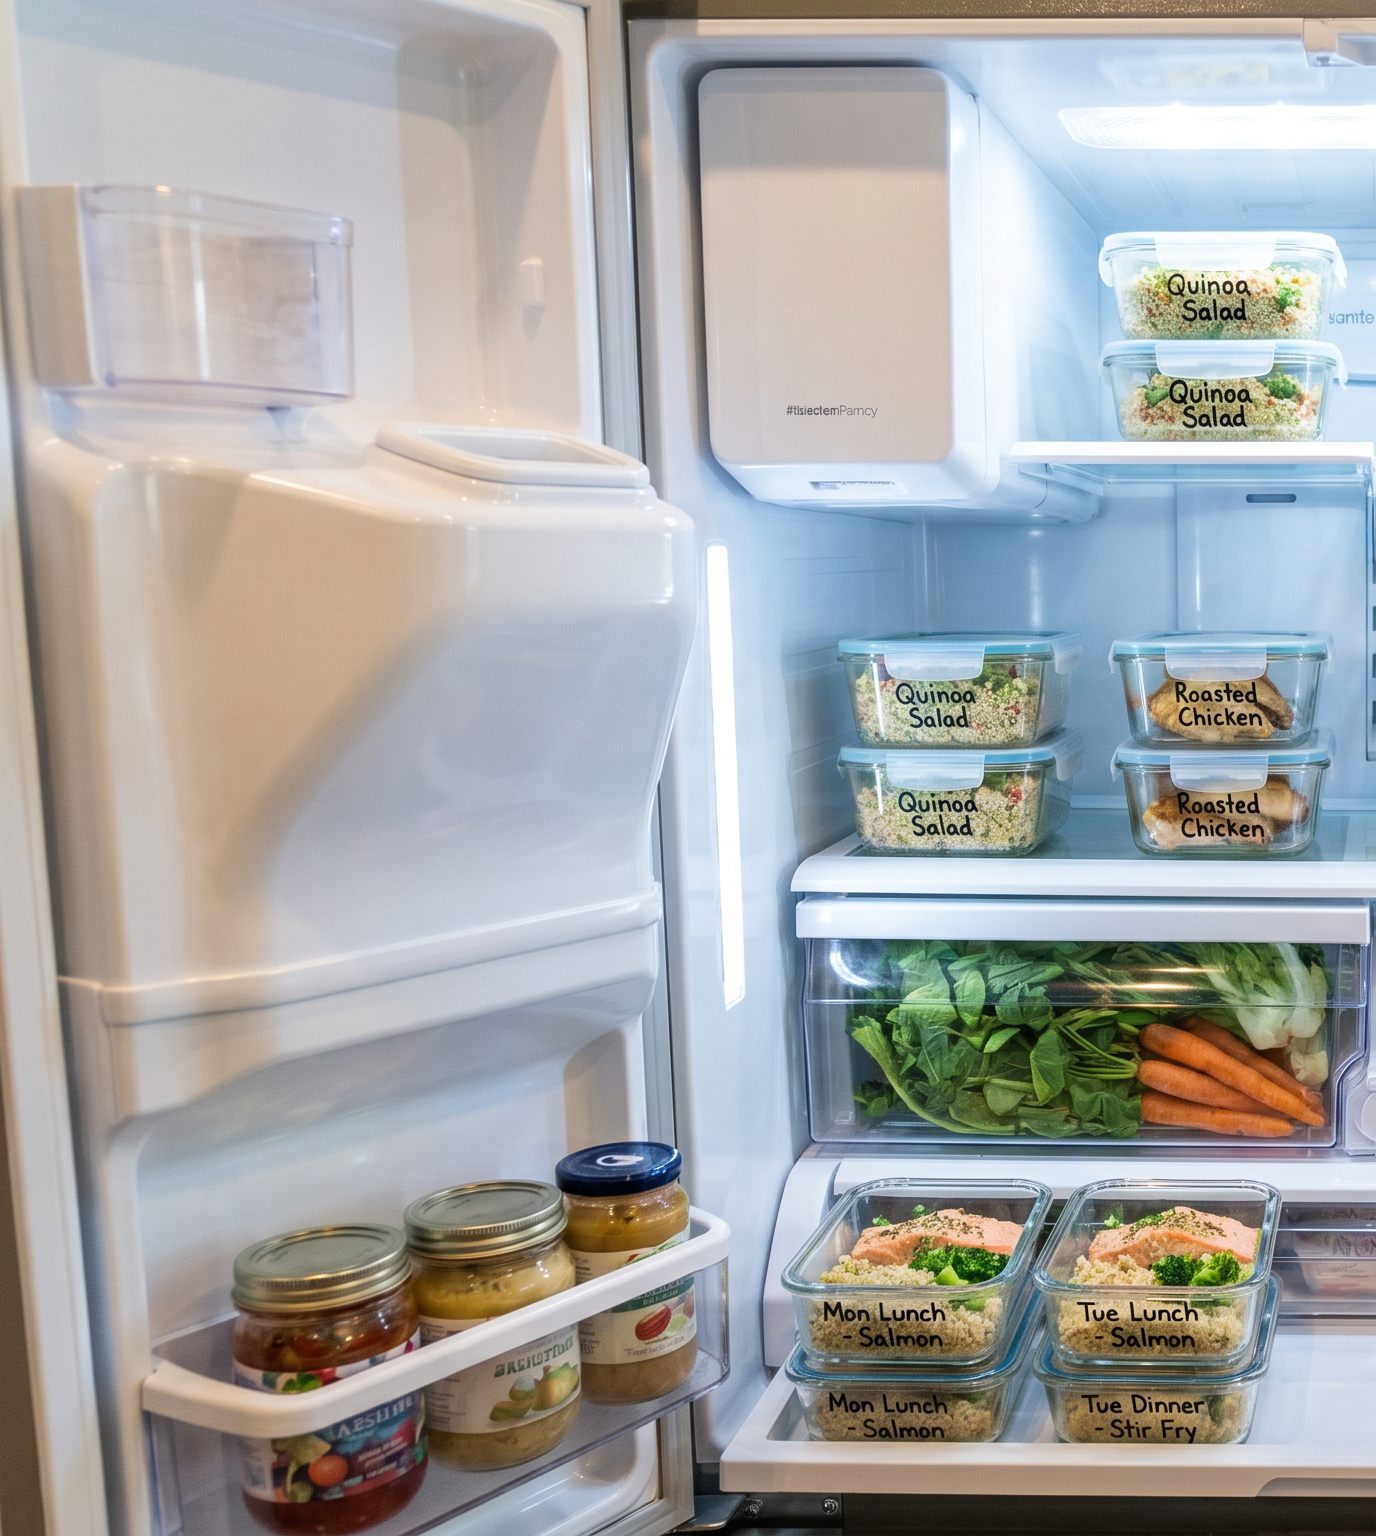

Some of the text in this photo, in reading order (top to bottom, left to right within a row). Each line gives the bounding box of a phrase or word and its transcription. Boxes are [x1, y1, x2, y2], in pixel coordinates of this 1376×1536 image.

[1166, 273, 1250, 297] Quinoa
[1181, 299, 1248, 322] Salad
[1168, 379, 1253, 404] Quinoa
[1181, 405, 1248, 429] Salad
[895, 682, 976, 705] Quinoa
[1174, 681, 1258, 704] Roasted
[909, 707, 970, 729] Salad
[1178, 707, 1263, 728] Chicken
[898, 791, 979, 814] Quinoa
[1177, 791, 1261, 815] Roasted
[912, 814, 974, 838] Salad
[1181, 817, 1265, 839] Chicken
[823, 1301, 947, 1323] Mon Lunch
[1076, 1301, 1199, 1323] Tue Lunch
[858, 1326, 944, 1348] Salmon
[1110, 1326, 1197, 1350] Salmon
[828, 1393, 949, 1415] Mon Lunch
[1082, 1393, 1206, 1415] Tue Dinner
[863, 1418, 945, 1440] Salmon
[1110, 1418, 1153, 1440] Stir
[1161, 1418, 1198, 1444] Fry
